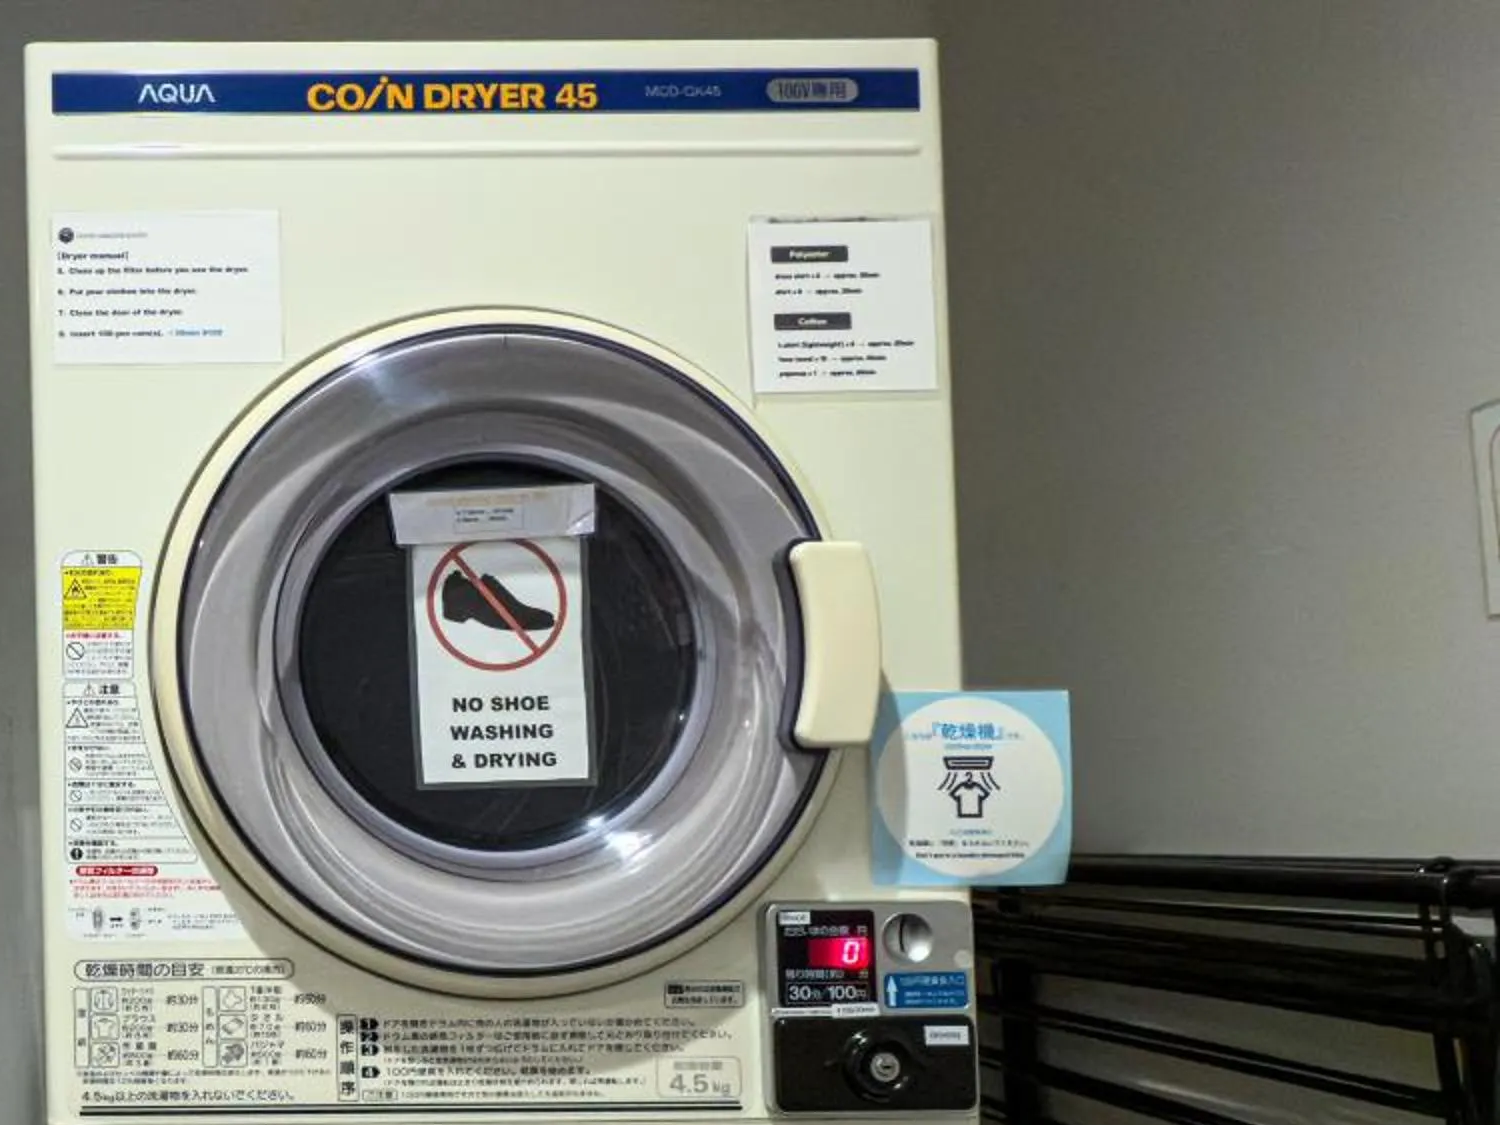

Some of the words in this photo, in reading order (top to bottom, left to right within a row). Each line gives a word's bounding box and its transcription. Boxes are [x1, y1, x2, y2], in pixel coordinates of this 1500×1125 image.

[139, 83, 215, 103] AQUA
[424, 83, 544, 109] DRYER
[556, 84, 597, 108] 45
[453, 697, 483, 712] NO
[491, 696, 549, 712] SHOE
[450, 724, 553, 740] WASHING
[452, 754, 466, 768] &
[475, 752, 556, 768] DRYING
[843, 940, 860, 965] 0
[85, 963, 204, 977] 乾燥時間の目安
